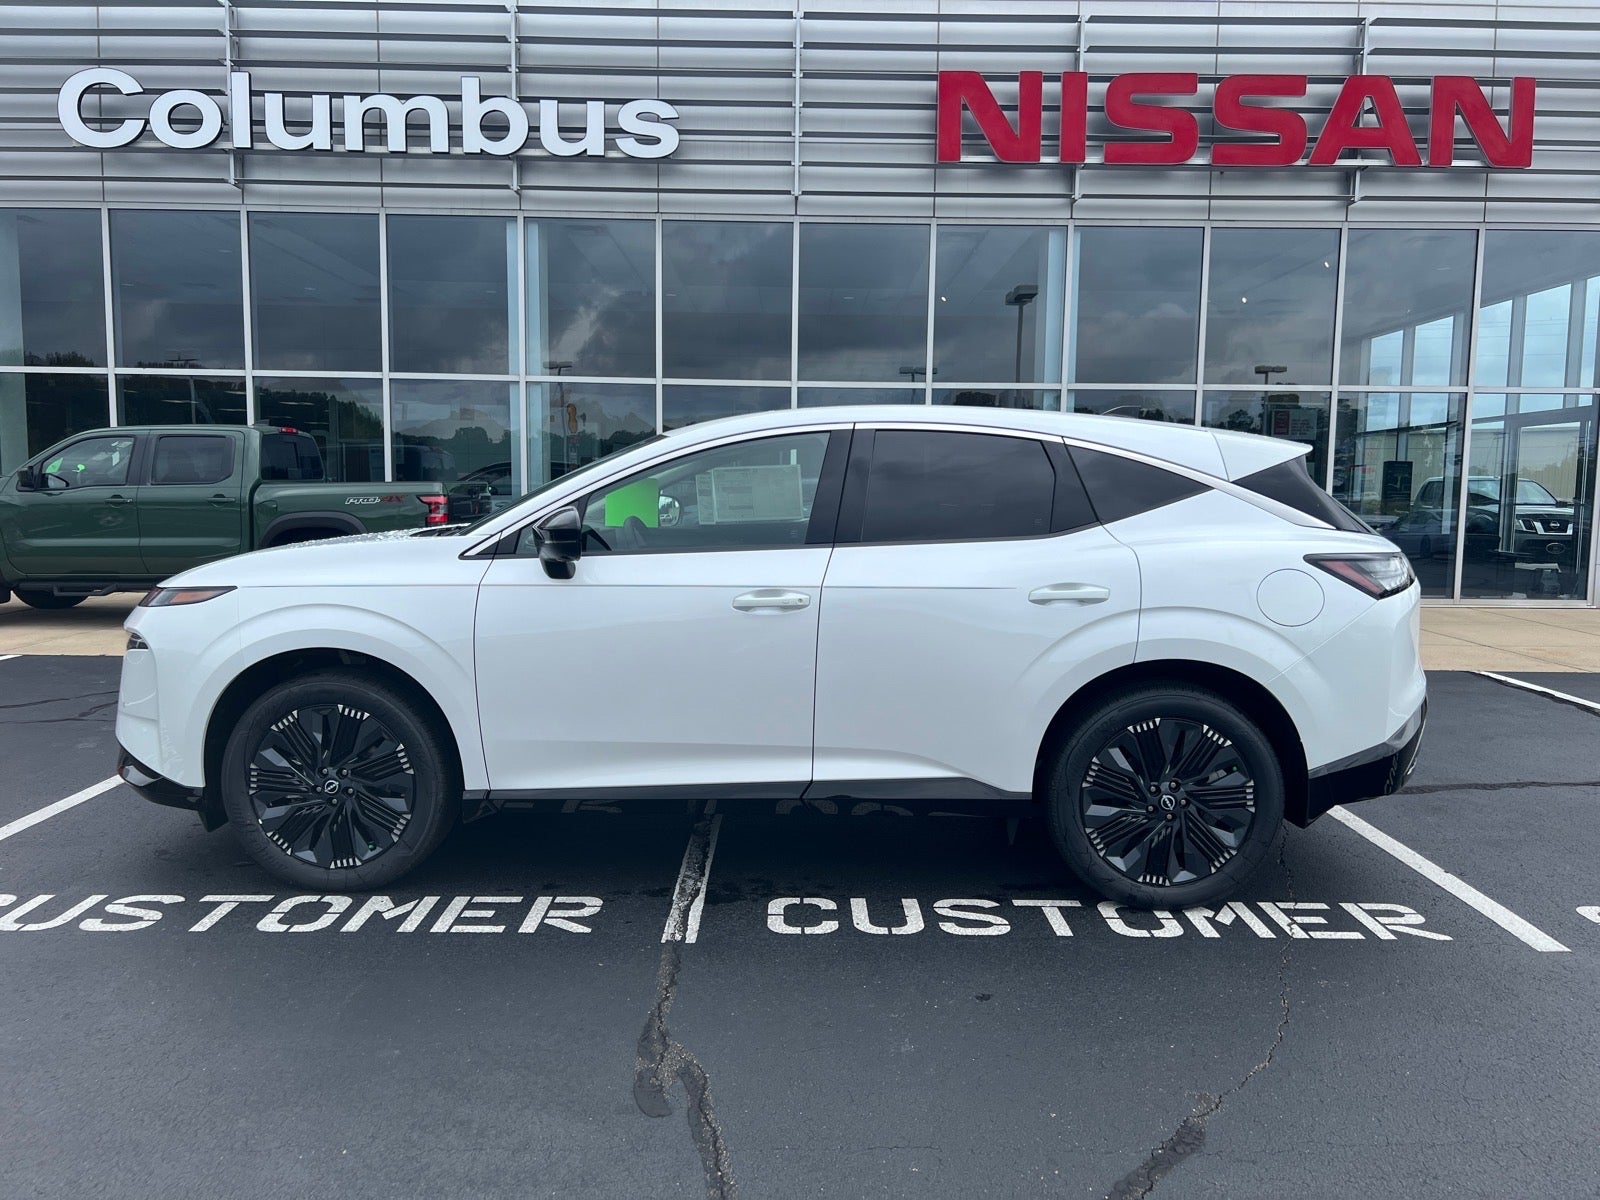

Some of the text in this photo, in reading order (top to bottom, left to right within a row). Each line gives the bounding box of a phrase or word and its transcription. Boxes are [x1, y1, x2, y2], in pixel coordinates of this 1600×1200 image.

[57, 67, 681, 159] Columbus
[938, 71, 1536, 168] NISSAN
[0, 893, 604, 934] USTOMER
[767, 897, 1453, 941] CUSTOMER
